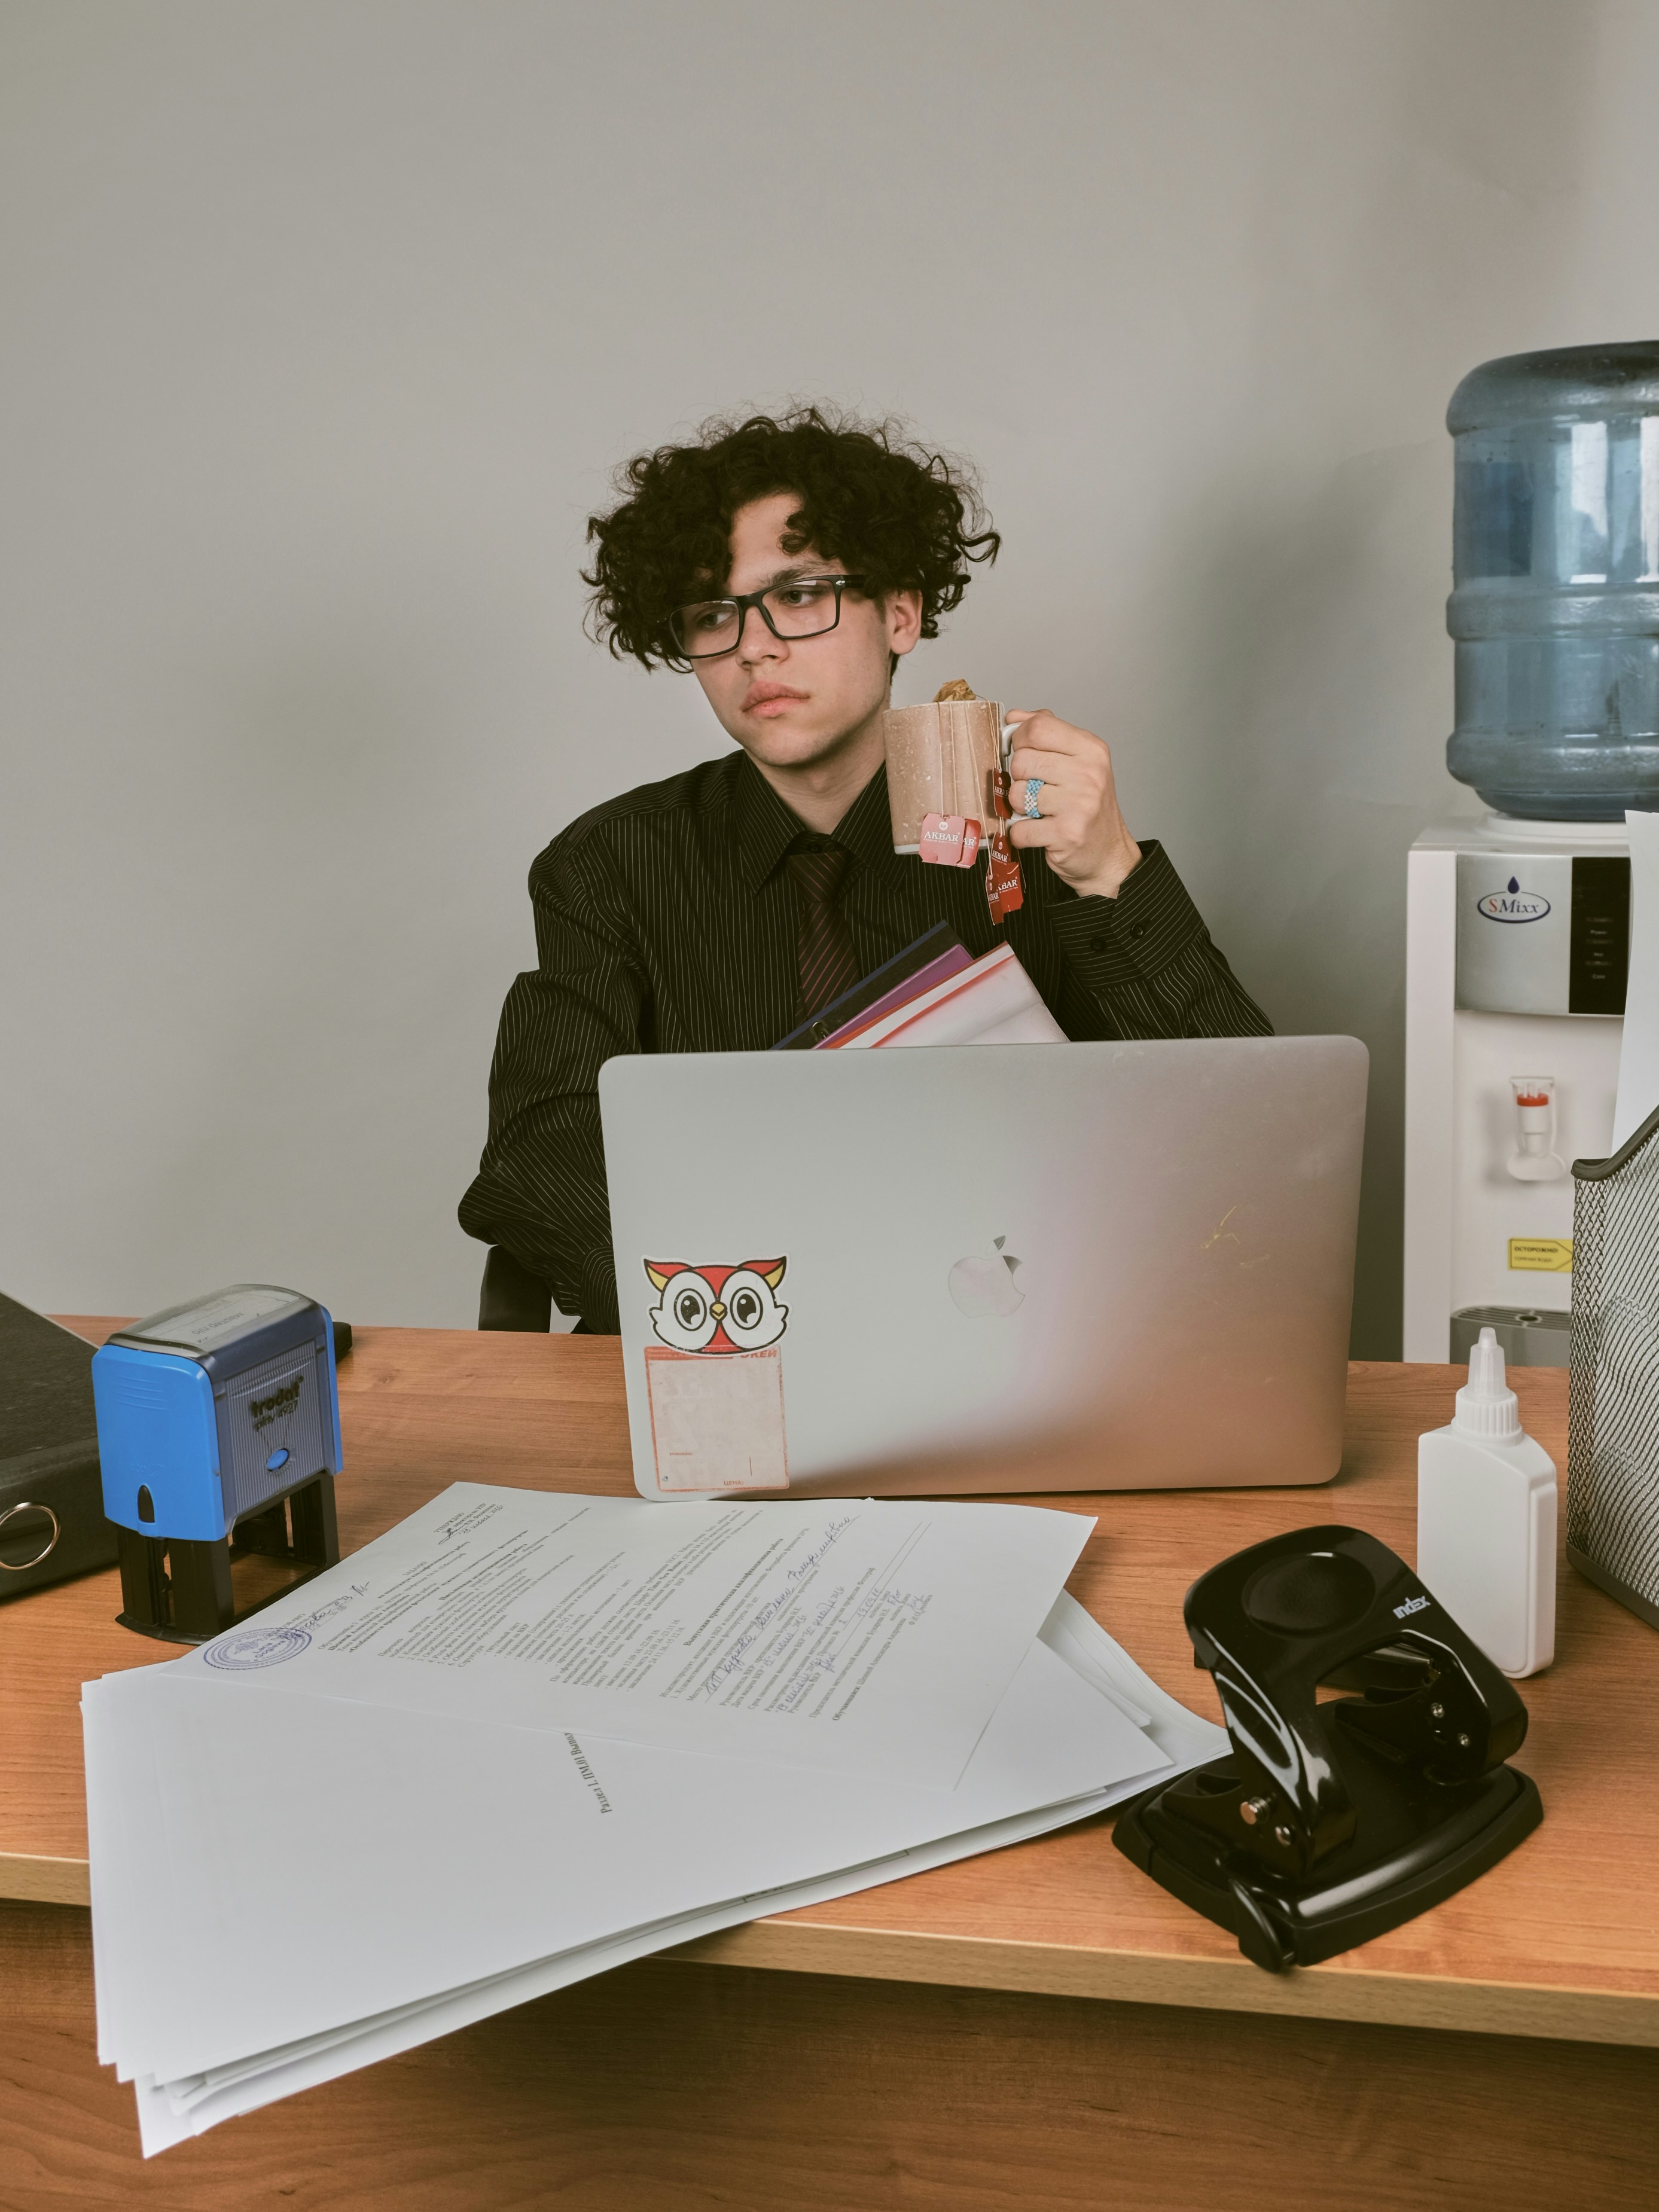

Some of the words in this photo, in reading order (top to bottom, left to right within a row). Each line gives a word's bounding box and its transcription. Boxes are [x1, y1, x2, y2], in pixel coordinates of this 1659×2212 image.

[924, 831, 958, 842] AKBAR
[992, 850, 1008, 862] AKBAR
[1489, 899, 1539, 914] SMixx
[251, 1381, 300, 1418] trodat
[277, 1400, 298, 1418] 4927
[1392, 1595, 1431, 1619] index
[252, 1642, 273, 1653] Lana
[574, 1756, 595, 1780] ПМ.01
[594, 1787, 612, 1814] Раздел
